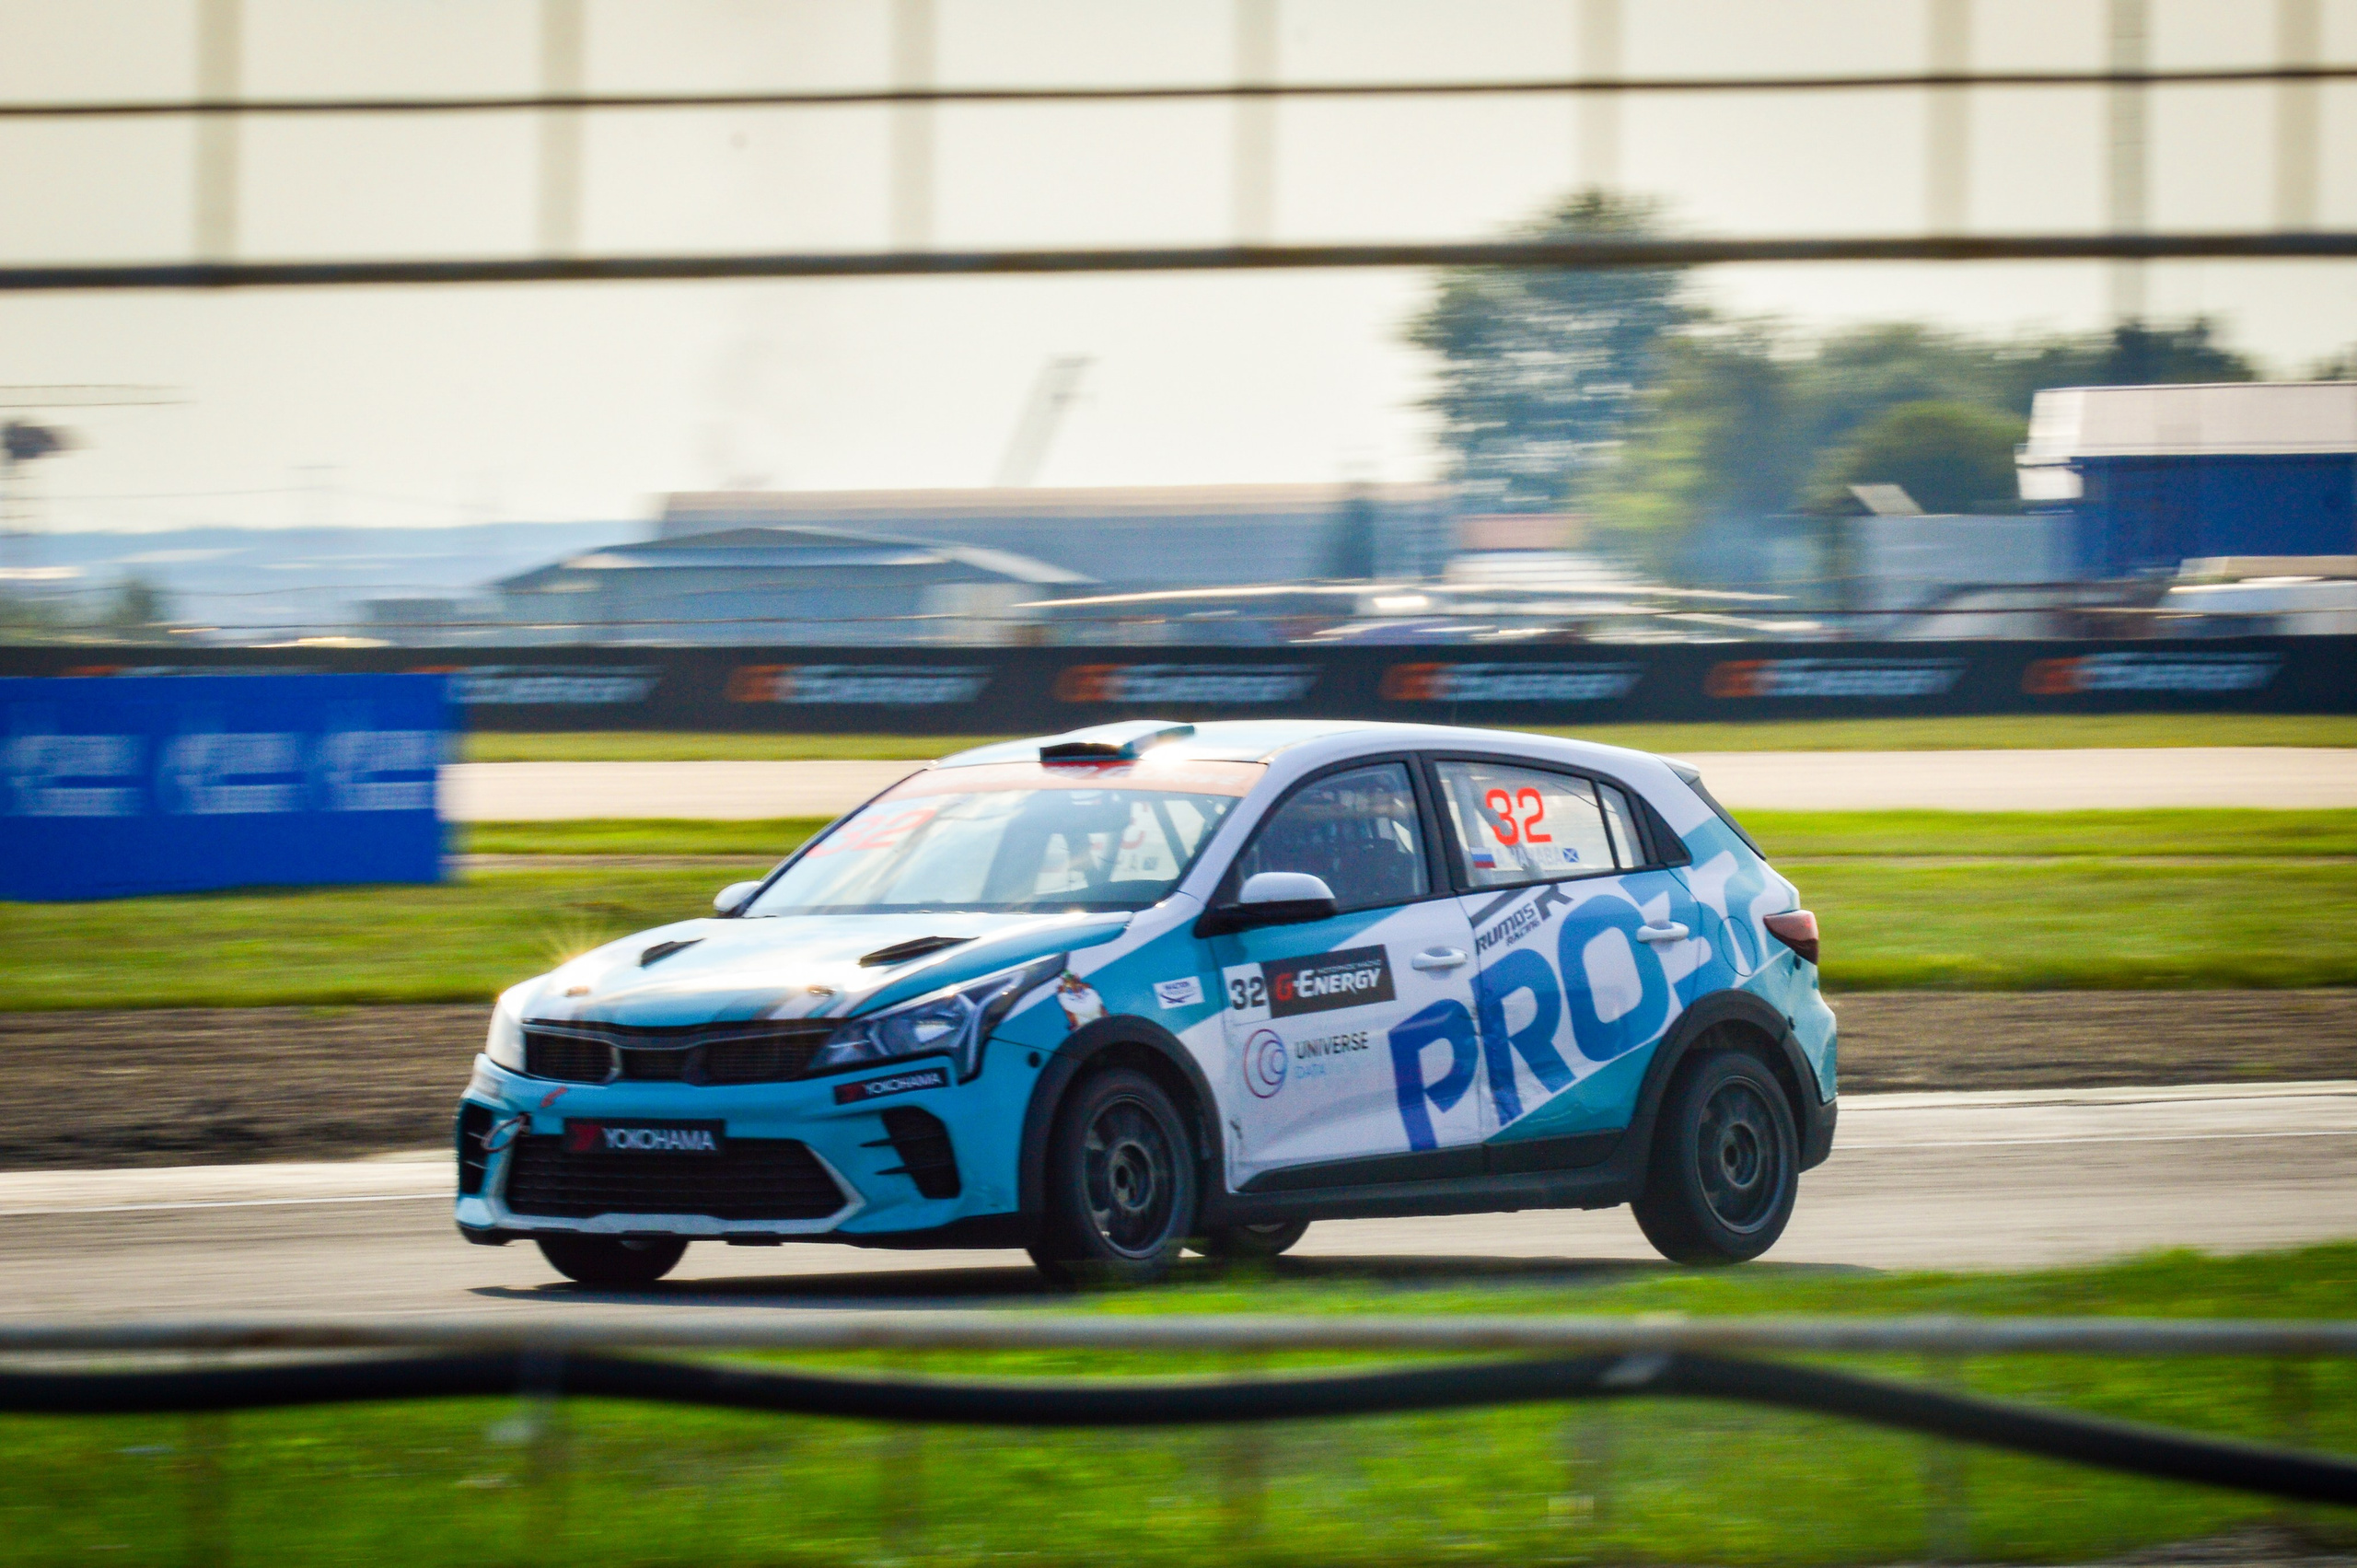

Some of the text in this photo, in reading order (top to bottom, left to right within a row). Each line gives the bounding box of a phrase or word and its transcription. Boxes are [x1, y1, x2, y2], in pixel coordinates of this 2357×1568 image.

[1484, 786, 1552, 846] 32
[1231, 976, 1267, 1010] 32
[1295, 1031, 1369, 1059] UNIVERSE
[862, 1073, 943, 1096] YOKOHAMA
[600, 1127, 718, 1151] YOKOHAMA
